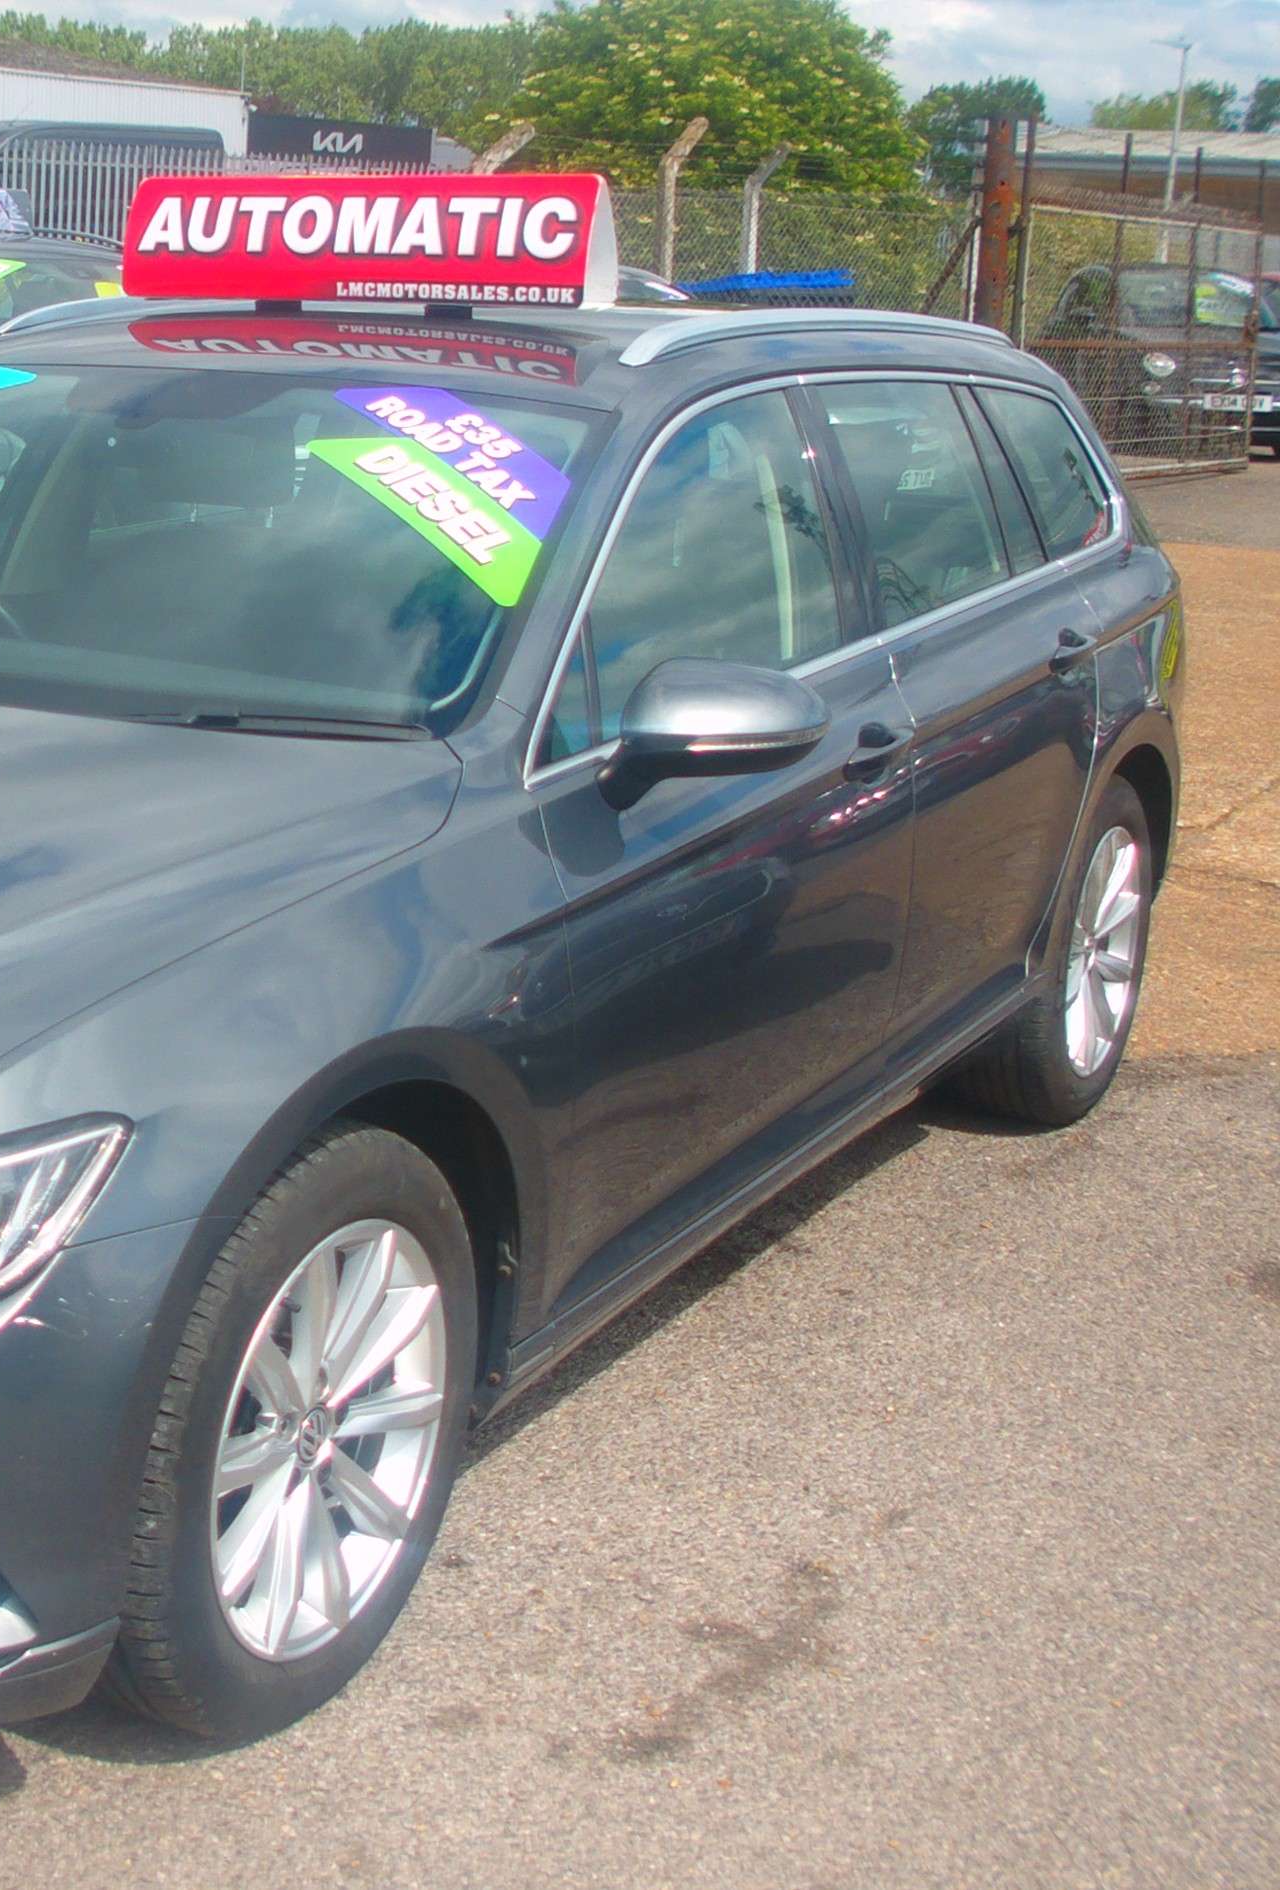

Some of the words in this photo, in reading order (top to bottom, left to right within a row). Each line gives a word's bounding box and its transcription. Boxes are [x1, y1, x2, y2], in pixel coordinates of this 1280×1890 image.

[313, 130, 363, 154] KIA
[137, 195, 578, 259] AUTOMATIC
[336, 281, 576, 304] LMCMOTORSALES.CO.UK
[365, 396, 463, 453] ROAD
[454, 451, 536, 510] TAX
[444, 413, 522, 459] £35
[353, 446, 512, 566] DIESEL
